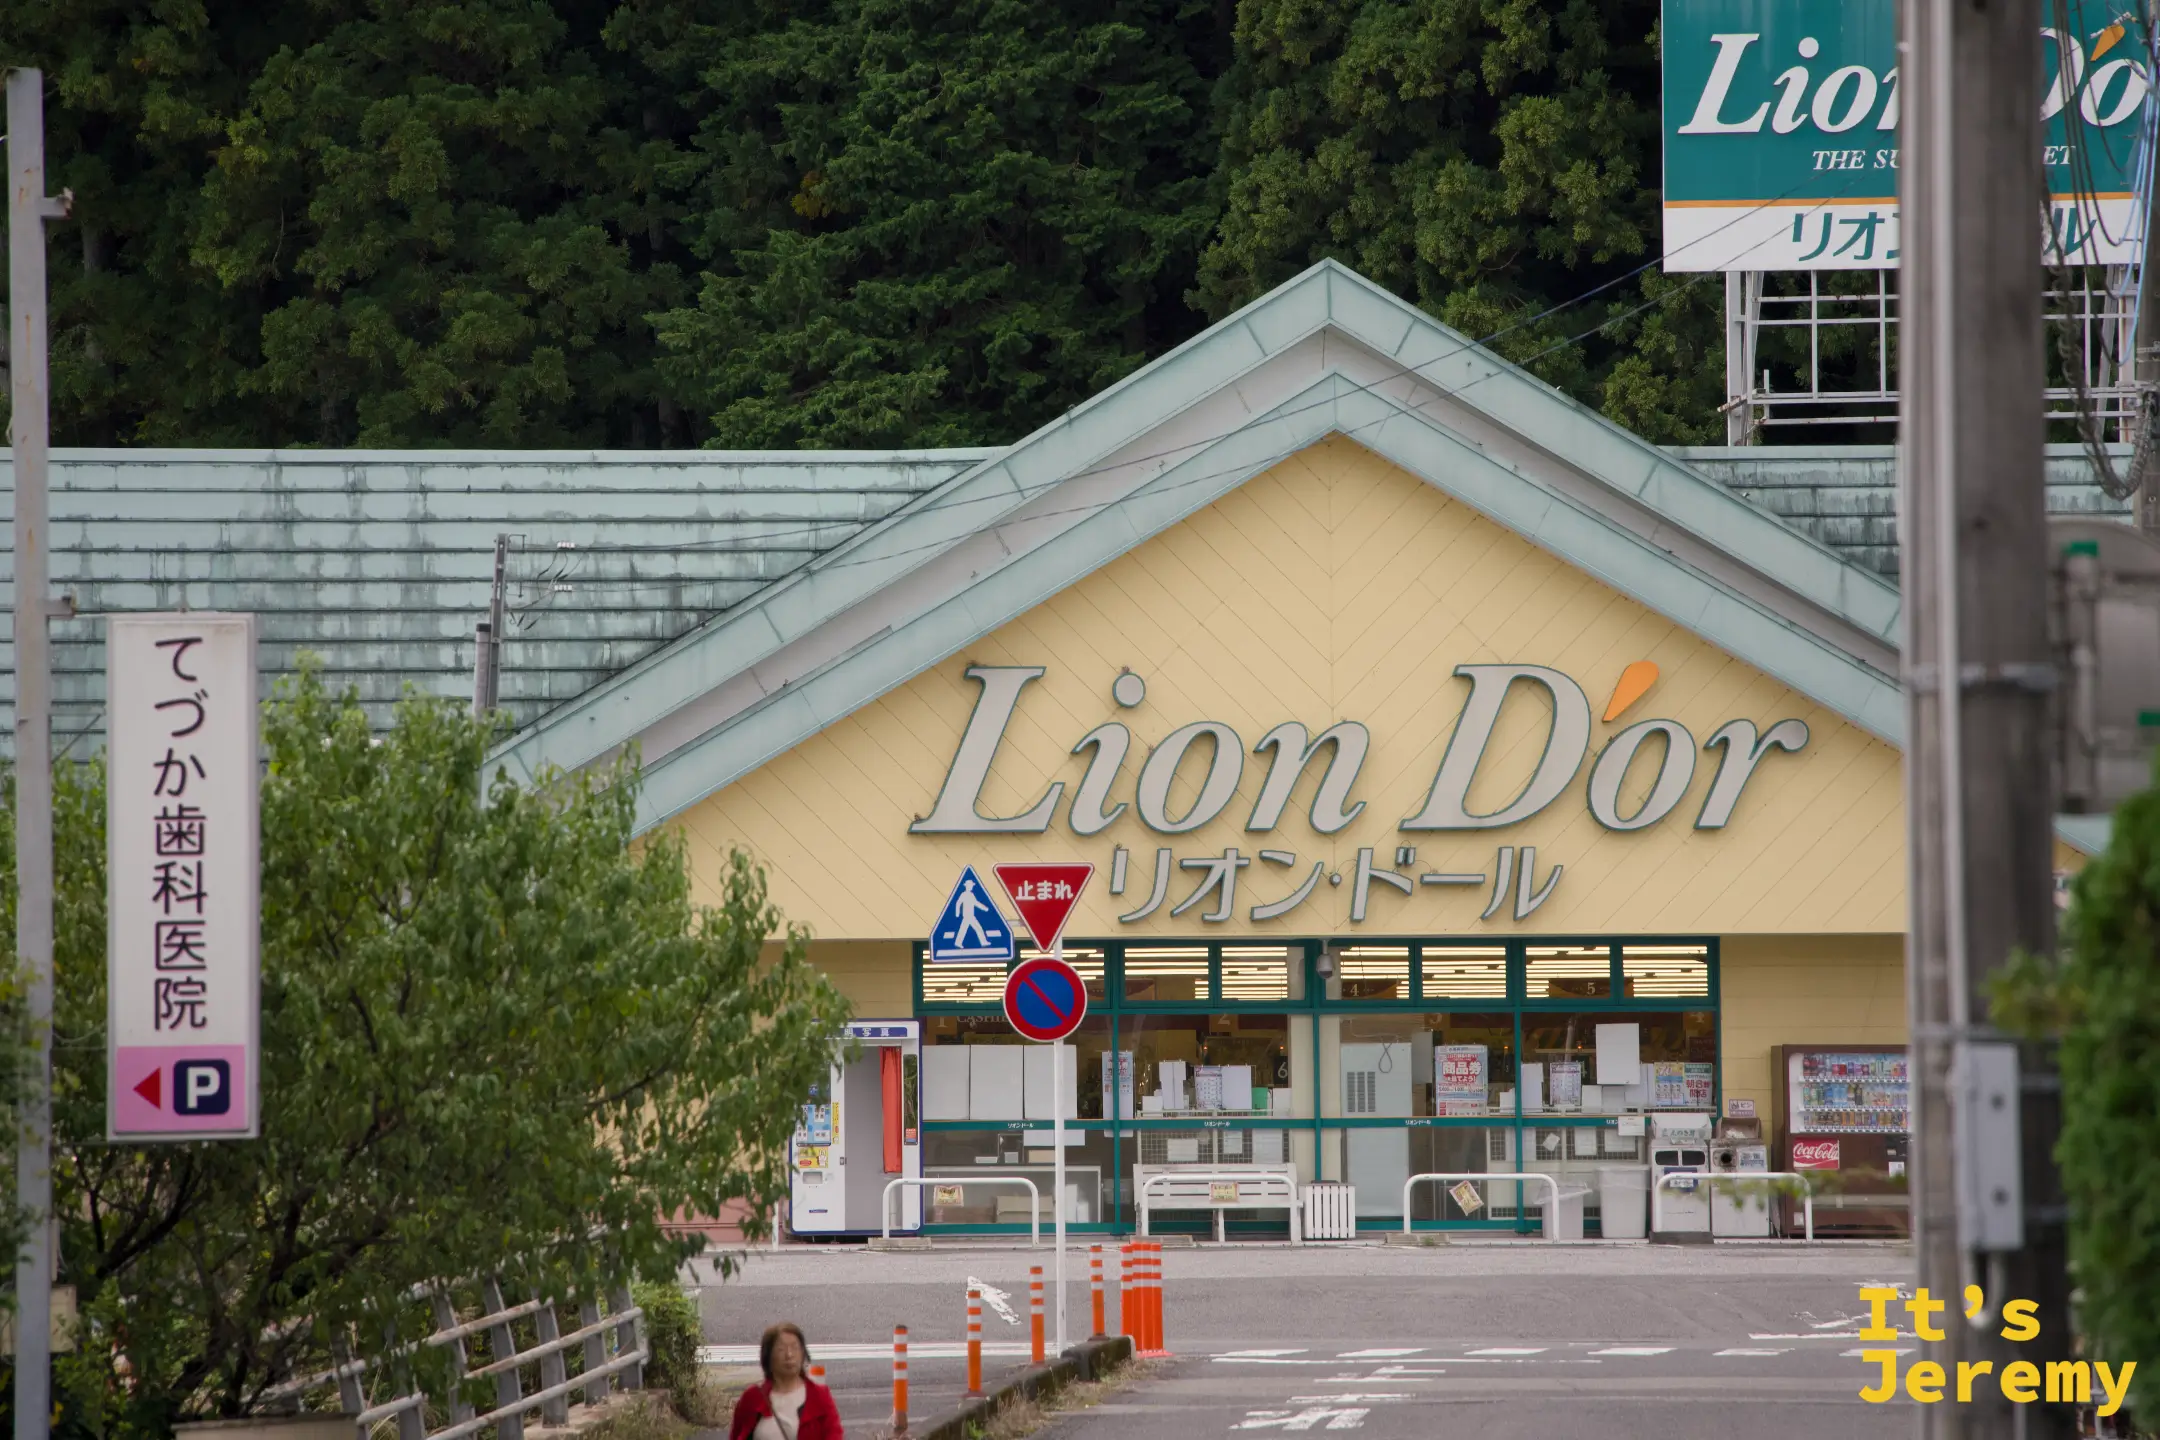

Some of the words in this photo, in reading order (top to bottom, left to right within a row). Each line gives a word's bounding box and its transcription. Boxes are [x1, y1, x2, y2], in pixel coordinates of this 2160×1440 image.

[1678, 33, 1900, 134] Lio
[1812, 150, 1866, 170] THE
[908, 664, 1371, 836] Lion
[1400, 660, 1810, 832] D'or
[152, 636, 208, 1032] てづか歯科医院
[1015, 879, 1074, 900] 止まれ
[1108, 844, 1564, 923] リオン・ドール
[1587, 982, 1596, 995] 5
[1277, 1061, 1288, 1079] 6
[1442, 1061, 1482, 1075] 商品券
[186, 1067, 221, 1109] P
